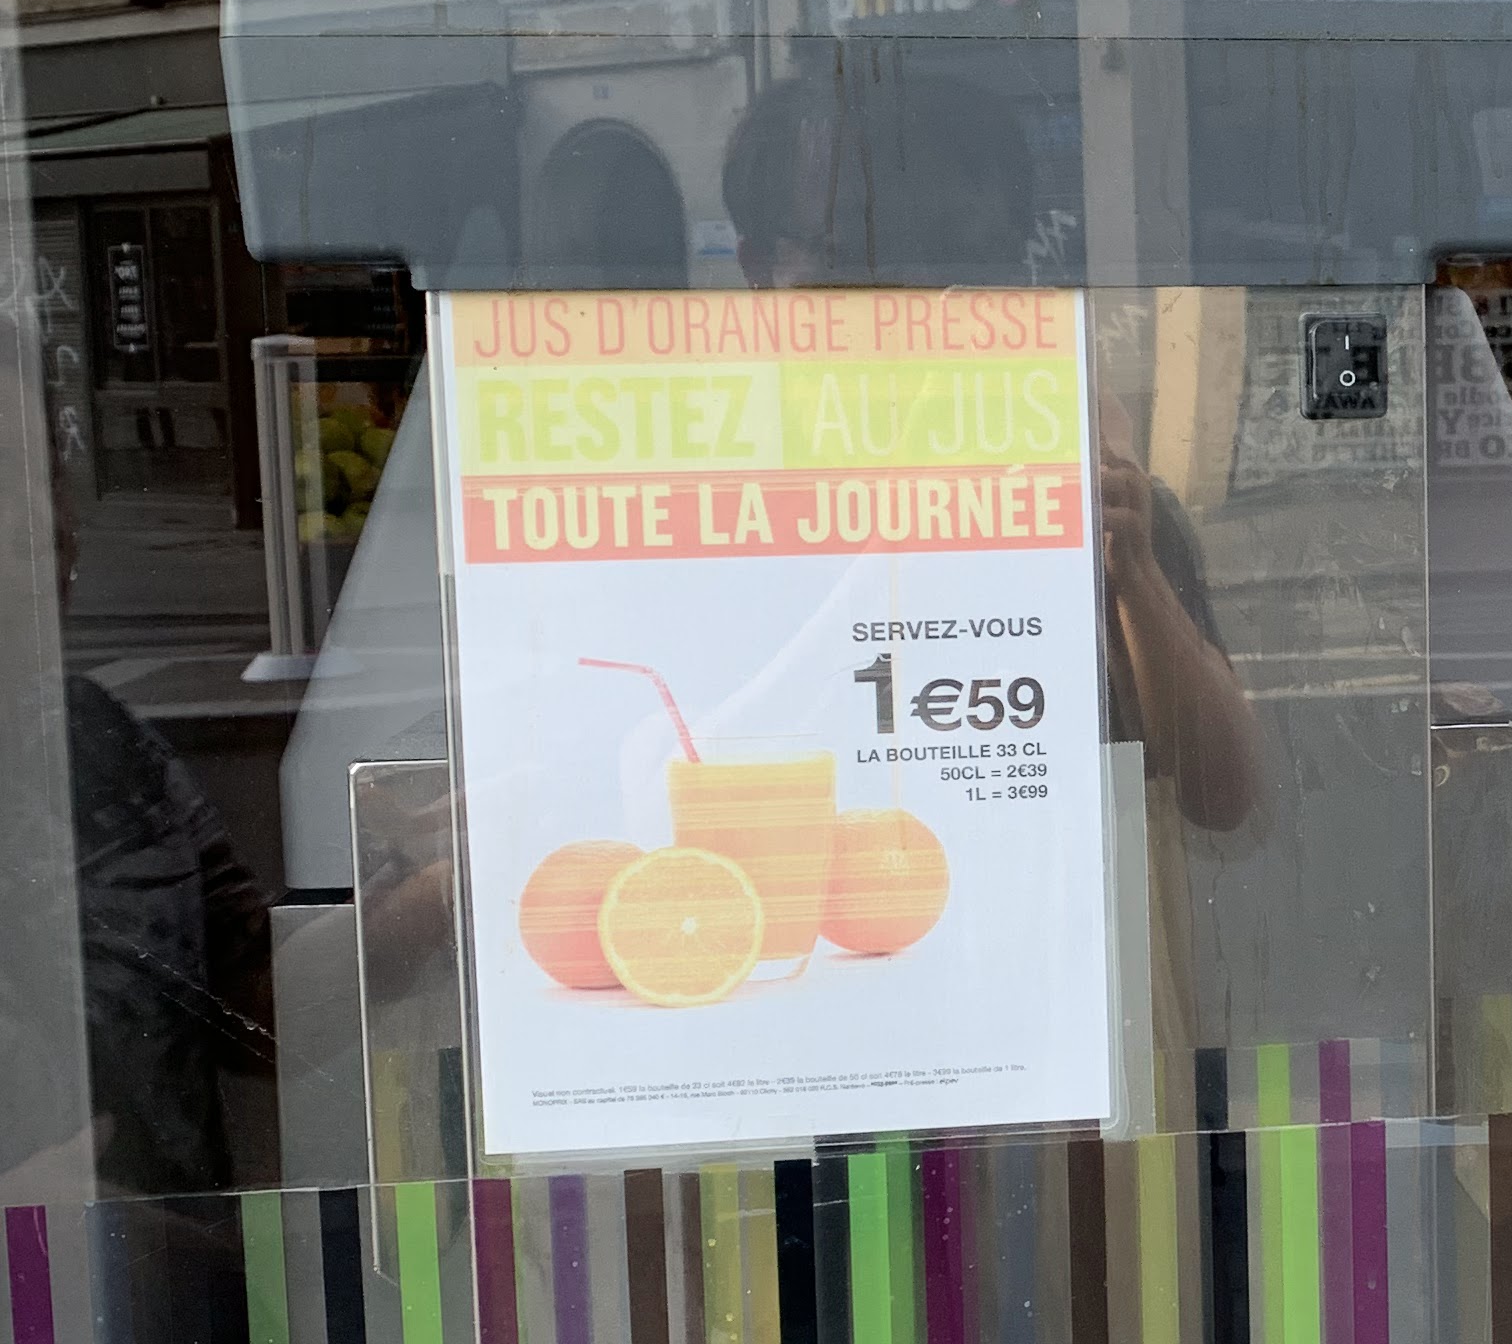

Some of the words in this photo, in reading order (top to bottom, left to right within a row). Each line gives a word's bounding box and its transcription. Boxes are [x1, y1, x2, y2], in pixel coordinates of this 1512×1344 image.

[474, 297, 572, 358] JUS
[597, 294, 847, 357] D'ORANGE
[478, 374, 756, 464] RESTEZ
[811, 373, 906, 458] AU
[928, 369, 1061, 456] JUS
[482, 485, 673, 550] TOUTE
[698, 482, 775, 546] LA
[797, 464, 1065, 544] JOURNÉE
[852, 617, 1042, 642] SERVEZ-VOUS
[857, 749, 881, 763] LA
[886, 744, 992, 762] BOUTEILLE
[996, 744, 1018, 758] 33
[1022, 742, 1047, 756] CL
[940, 766, 986, 781] 50CL
[1007, 763, 1048, 778] 2€39
[965, 787, 987, 801] 1L
[1007, 784, 1048, 799] 3€99
